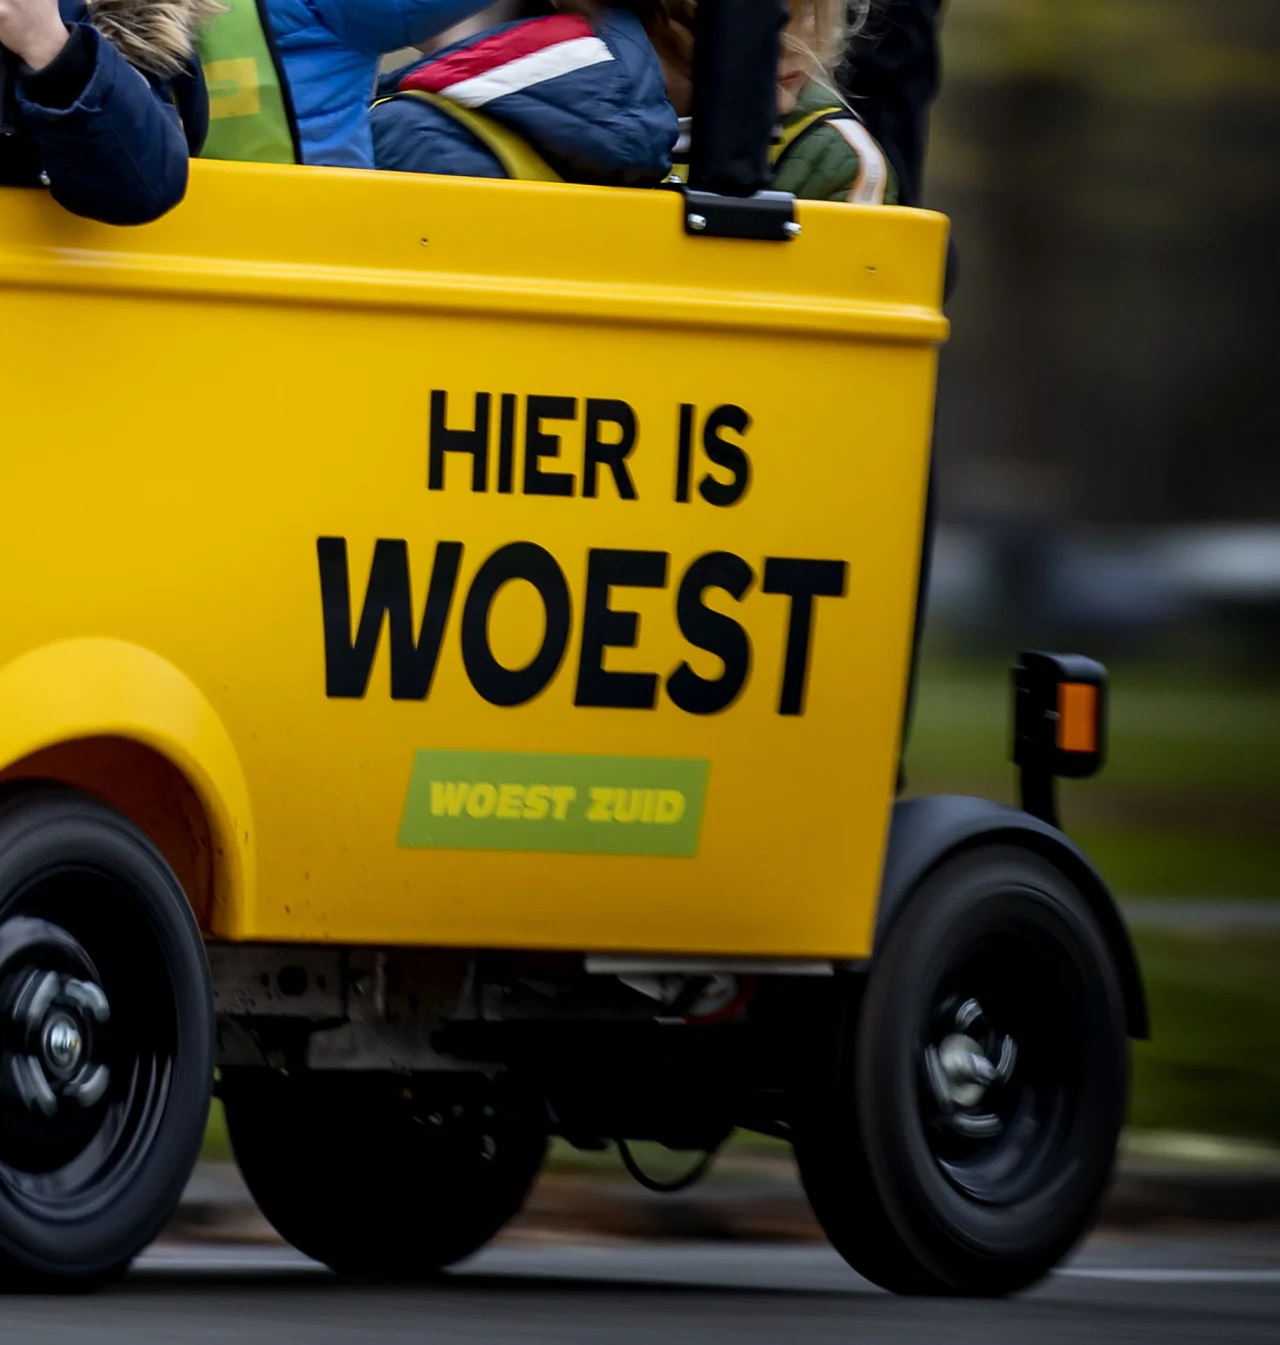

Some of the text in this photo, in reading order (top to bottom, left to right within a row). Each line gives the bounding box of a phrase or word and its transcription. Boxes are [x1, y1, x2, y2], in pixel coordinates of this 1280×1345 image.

[428, 389, 753, 507] HIER IS
[316, 535, 849, 717] WOEST
[430, 781, 686, 824] WOEST ZUID
